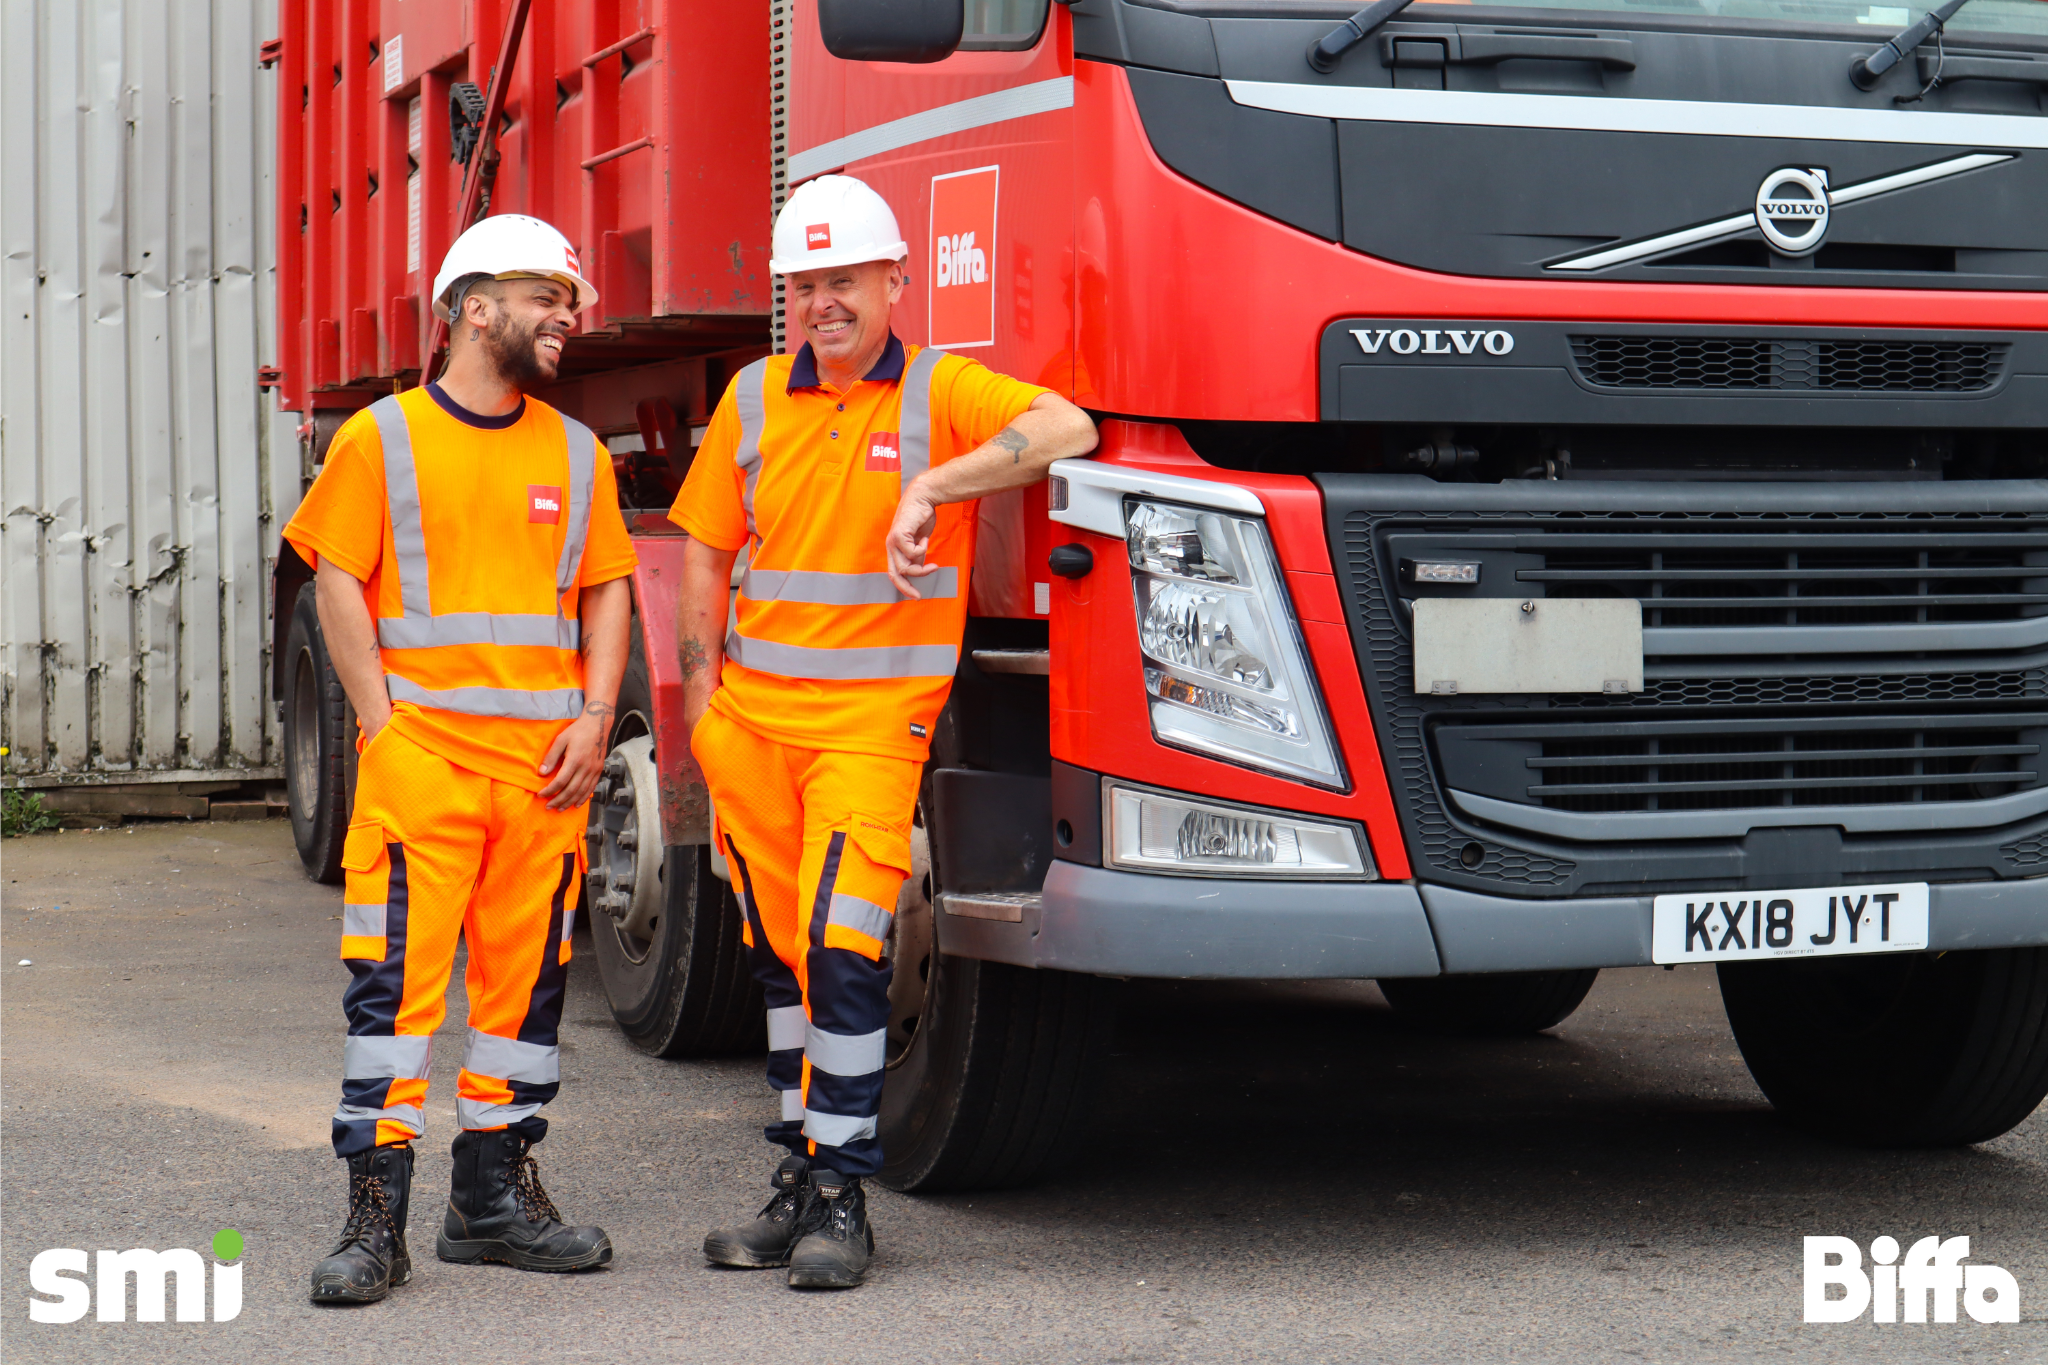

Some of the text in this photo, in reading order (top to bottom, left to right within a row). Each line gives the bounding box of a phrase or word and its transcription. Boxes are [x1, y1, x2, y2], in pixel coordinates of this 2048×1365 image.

[1760, 203, 1826, 215] VOLVO
[808, 231, 828, 242] Biffa
[936, 231, 986, 288] Biffa
[1348, 328, 1515, 356] VOLVO
[871, 445, 897, 458] Biffa
[534, 497, 559, 512] Biffa
[1685, 893, 1900, 952] KX18 JYT
